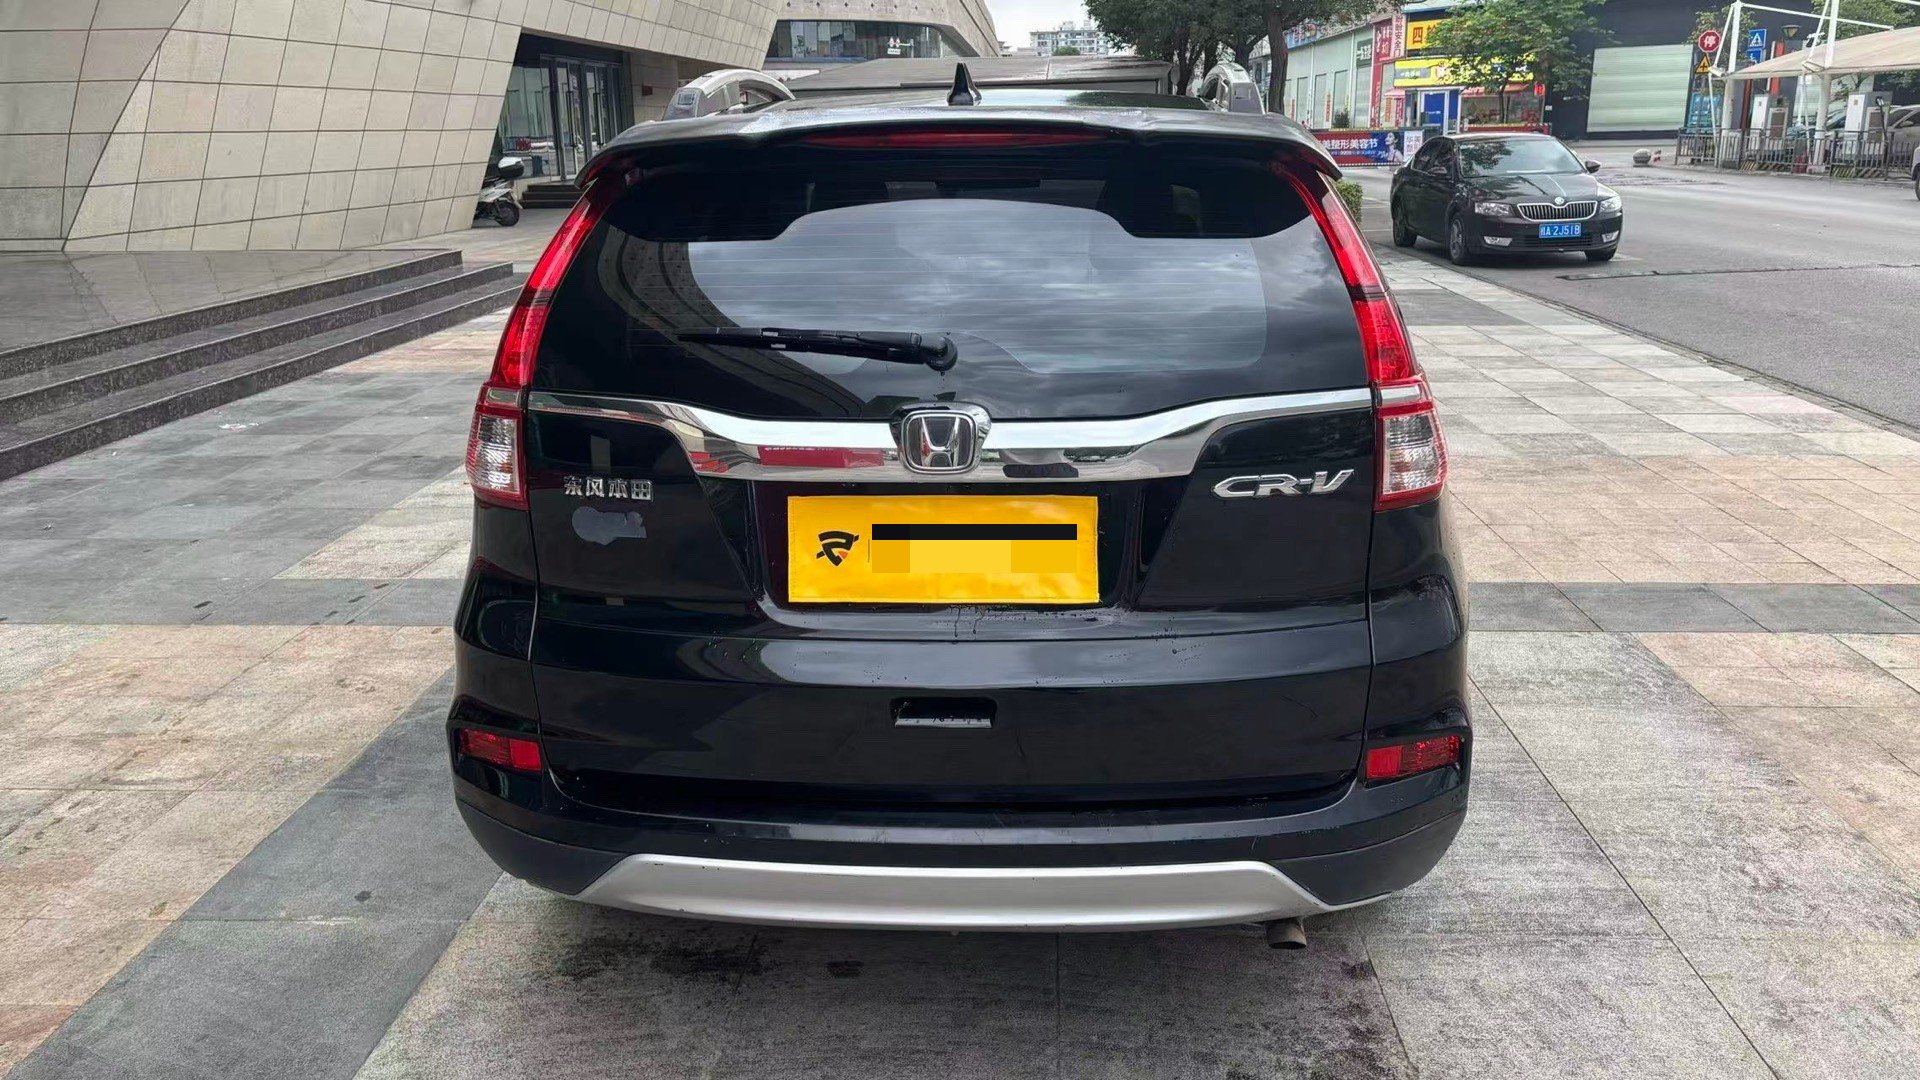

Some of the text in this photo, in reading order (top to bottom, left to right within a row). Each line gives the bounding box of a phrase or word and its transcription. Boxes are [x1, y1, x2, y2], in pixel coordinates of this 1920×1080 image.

[1317, 138, 1378, 150] 美整形美容节
[563, 475, 653, 501] 东风本田
[1212, 469, 1354, 498] CR-V
